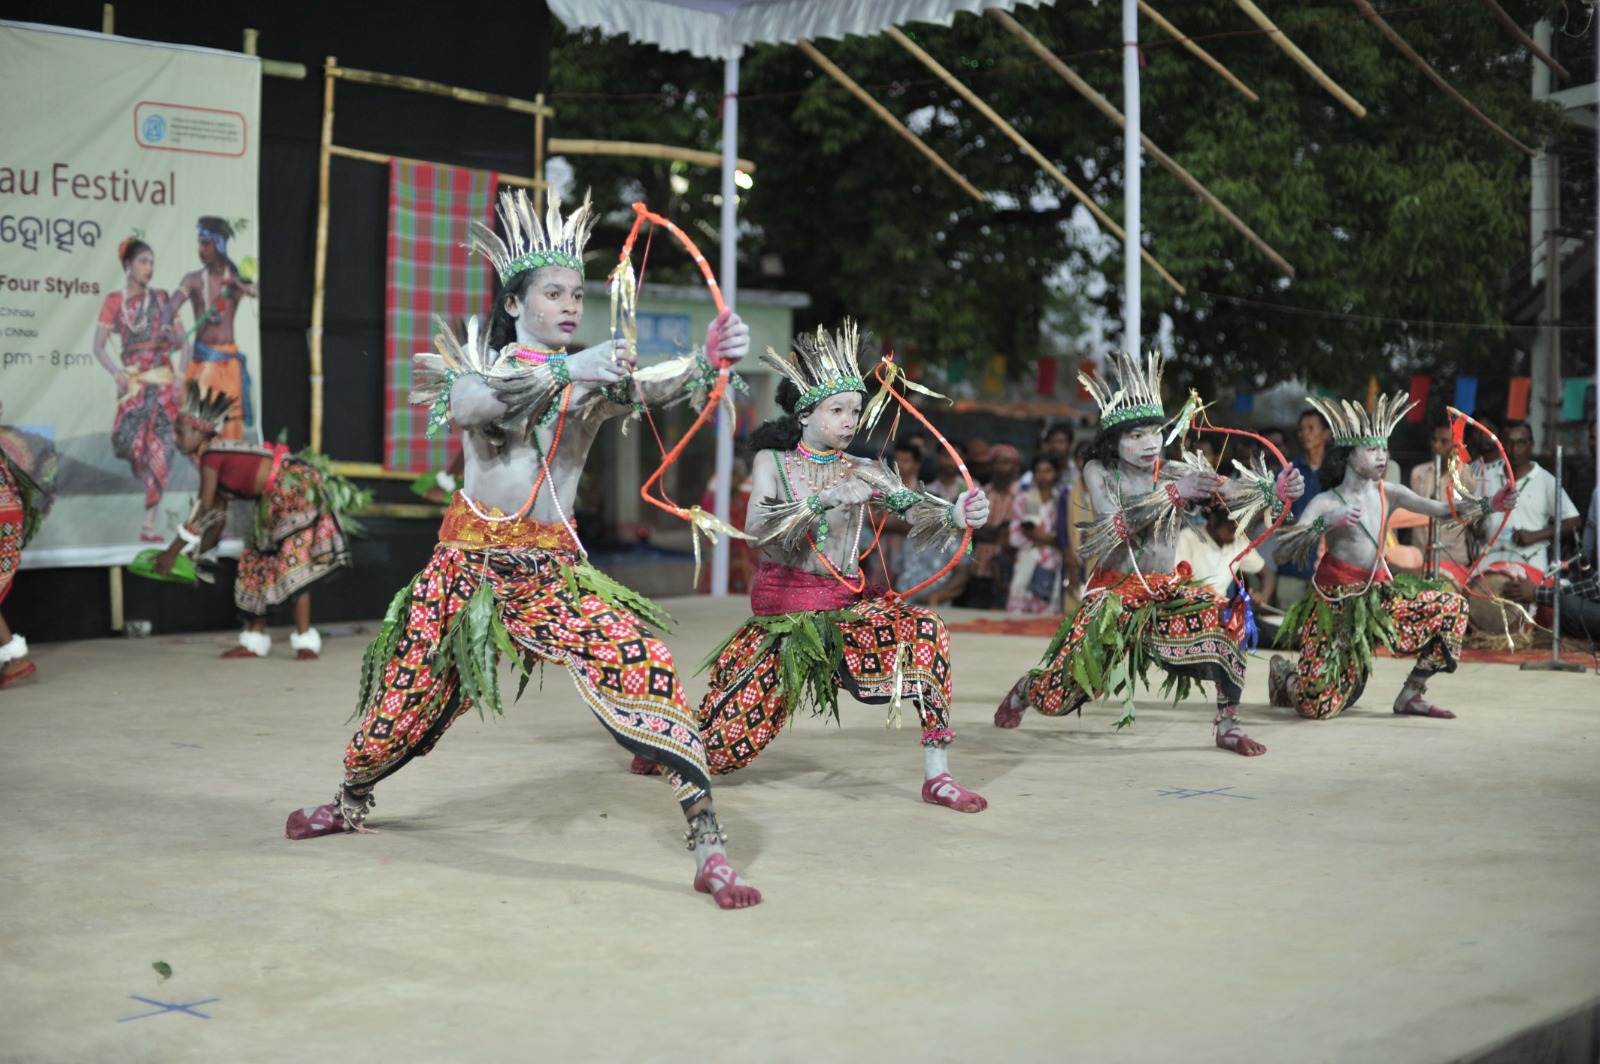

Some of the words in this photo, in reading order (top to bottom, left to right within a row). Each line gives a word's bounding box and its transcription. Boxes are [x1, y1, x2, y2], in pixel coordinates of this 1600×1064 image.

[52, 162, 175, 206] Festival
[0, 274, 40, 292] Four
[45, 277, 100, 299] Styles
[3, 352, 32, 369] pm
[64, 353, 93, 370] pm
